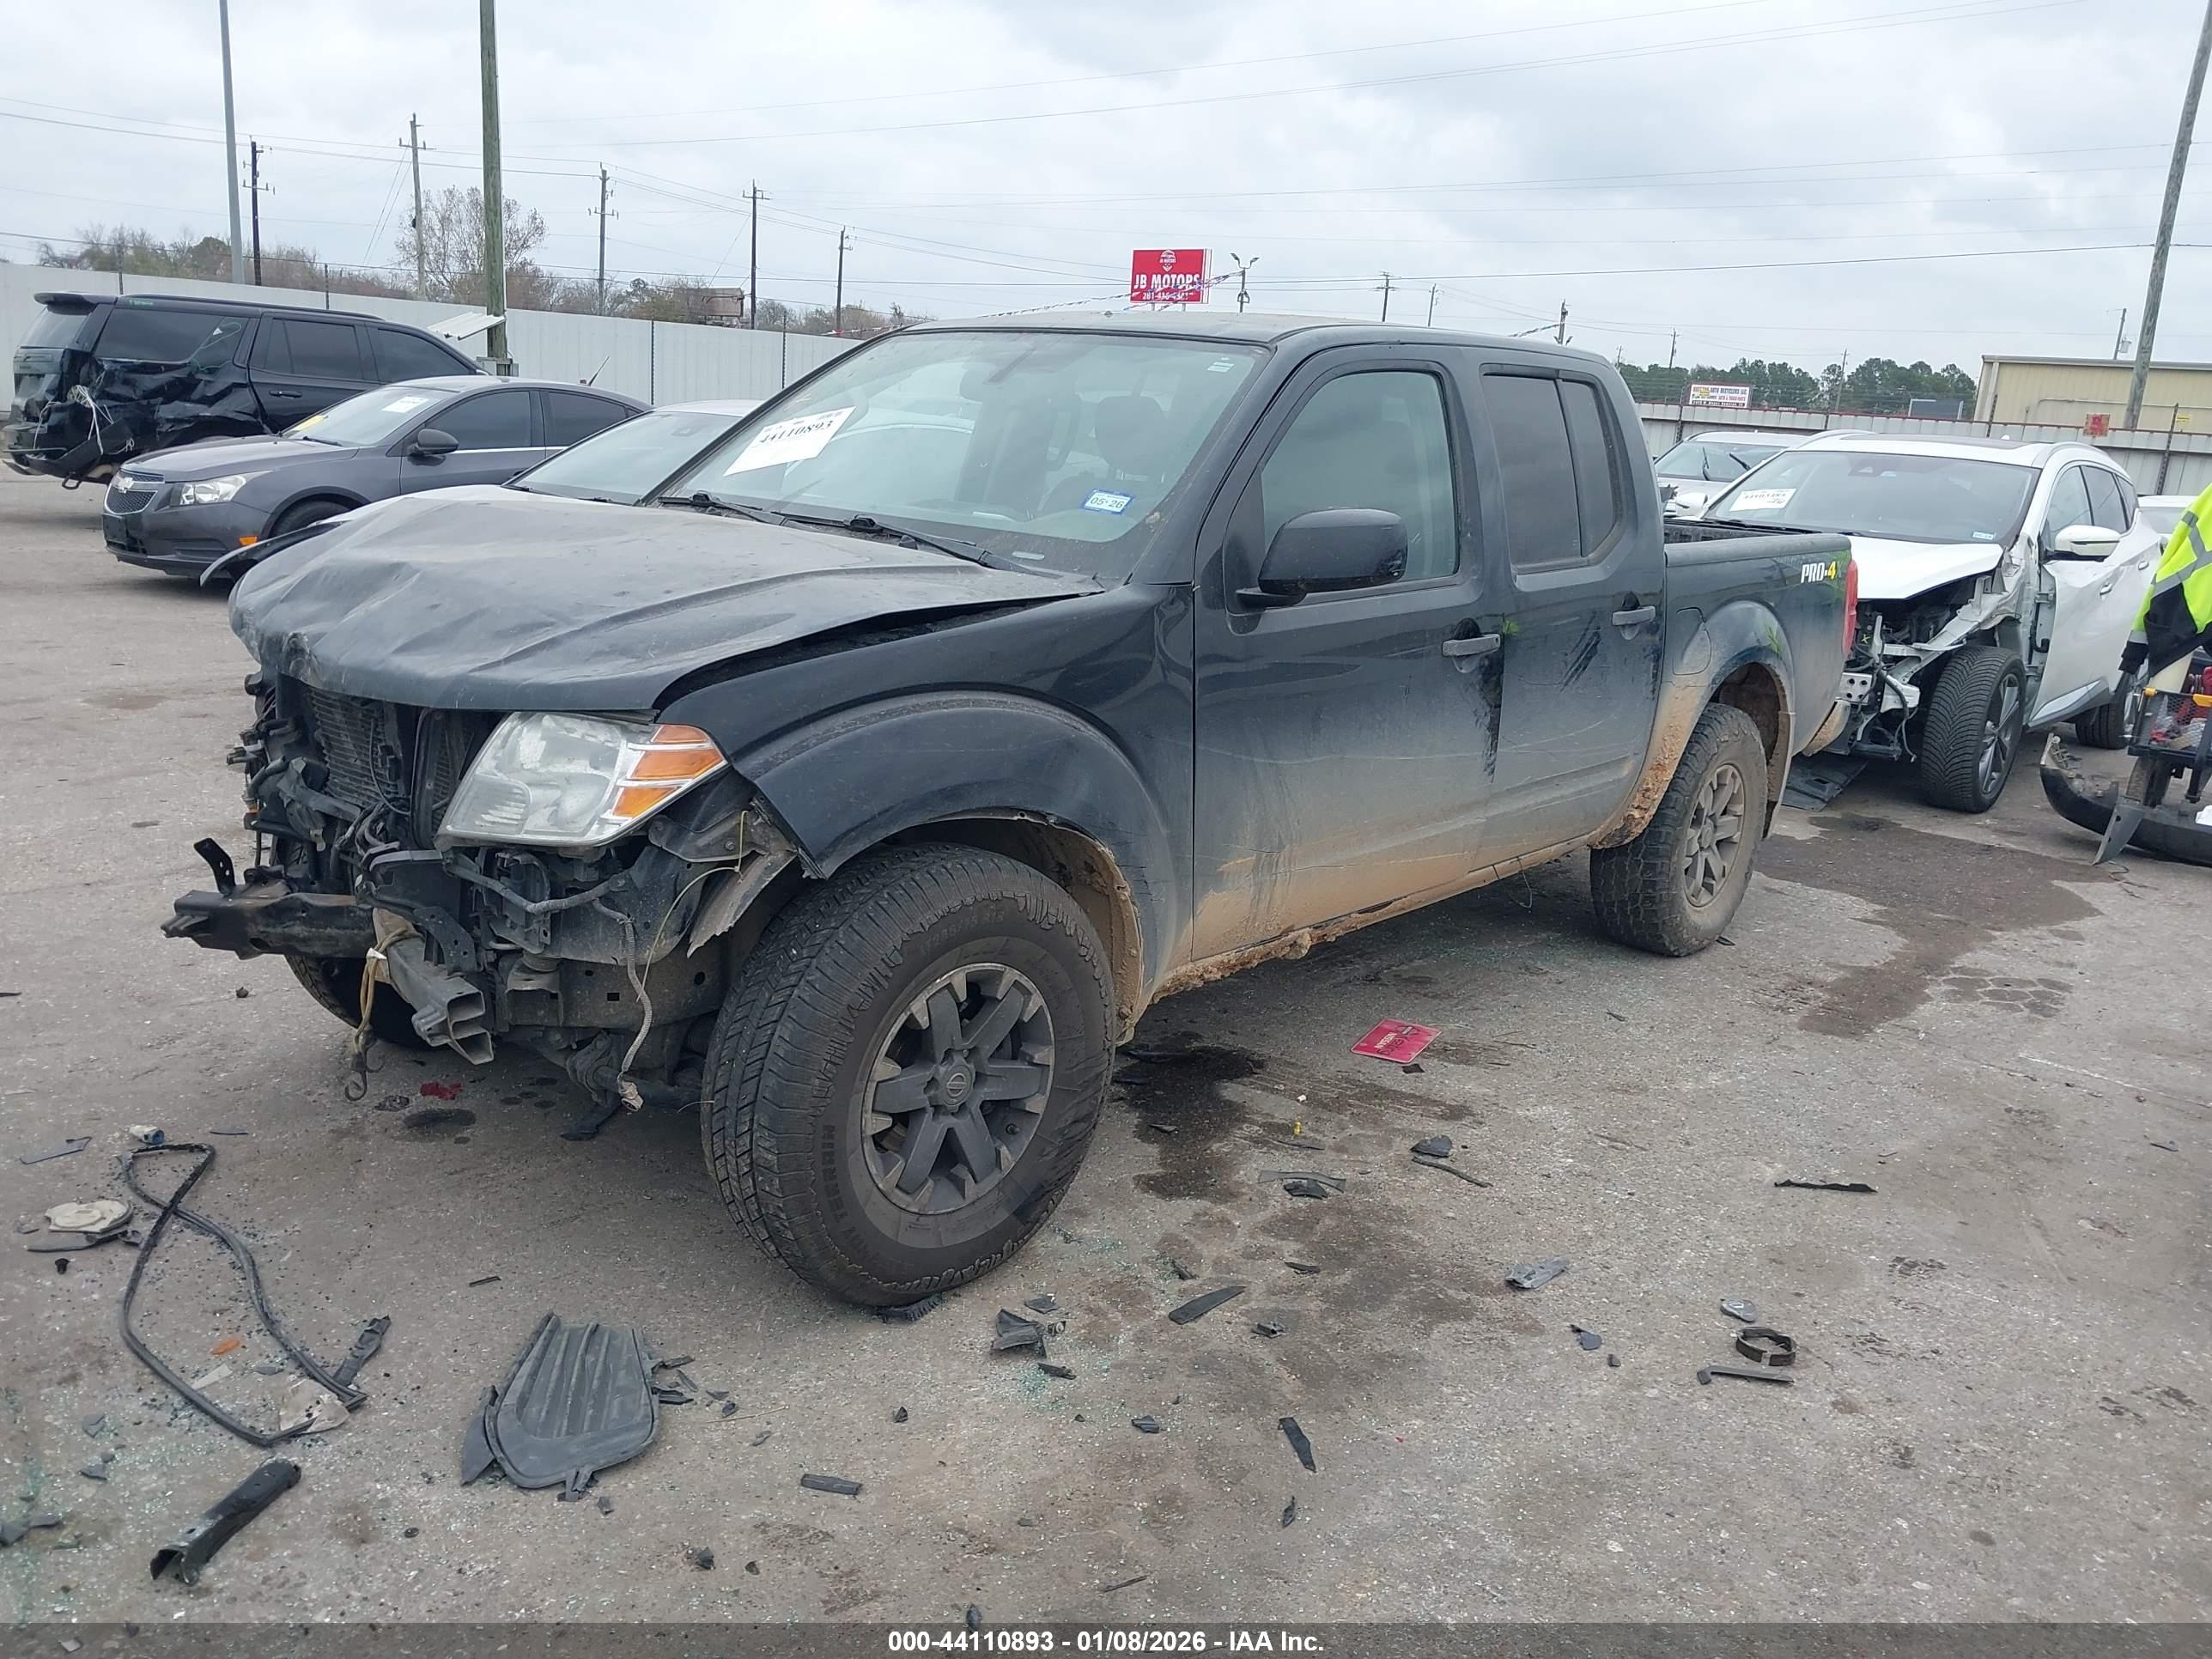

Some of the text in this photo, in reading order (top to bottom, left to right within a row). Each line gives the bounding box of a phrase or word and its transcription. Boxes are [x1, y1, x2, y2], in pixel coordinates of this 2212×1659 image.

[1133, 273, 1201, 290] JB MOTORS
[1109, 500, 1125, 508] 26
